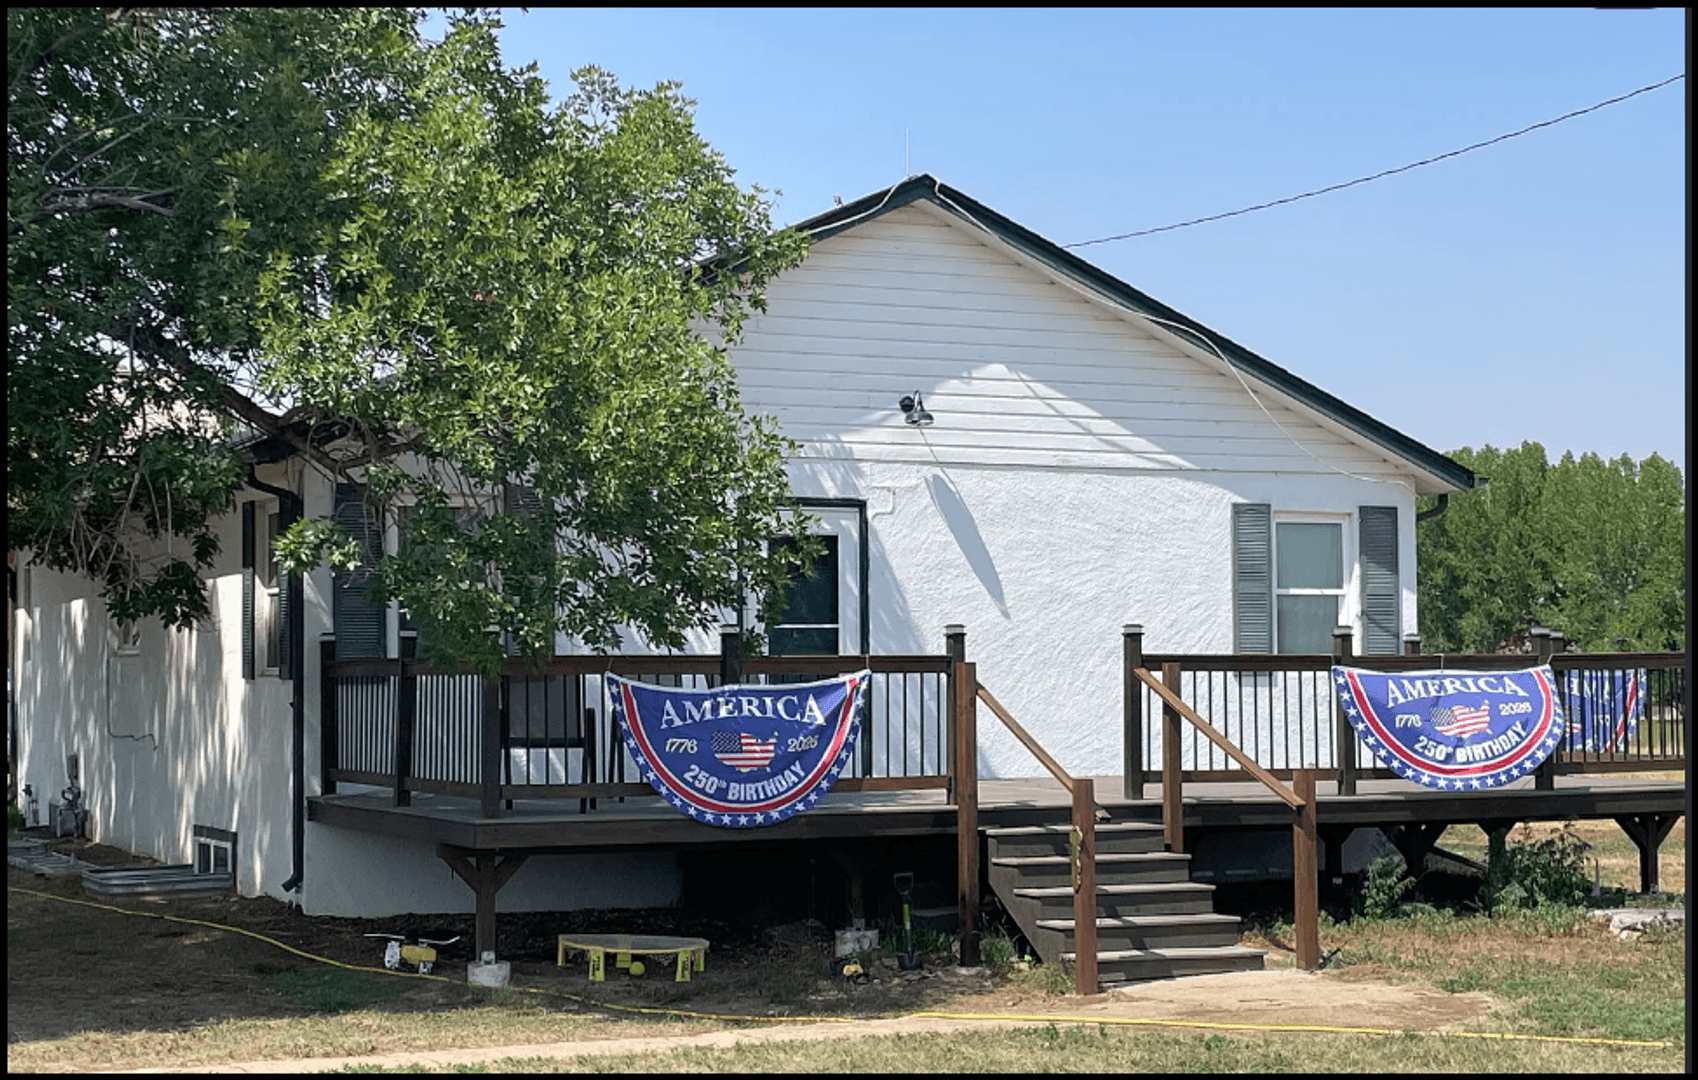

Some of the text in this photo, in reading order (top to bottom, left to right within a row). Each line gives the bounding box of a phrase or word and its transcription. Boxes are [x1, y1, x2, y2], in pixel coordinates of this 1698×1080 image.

[1387, 676, 1530, 708] AMERICA
[660, 693, 827, 729] AMERICA
[1395, 714, 1423, 728] 1776
[665, 738, 698, 754] 1776
[1414, 736, 1454, 761] 250
[1455, 720, 1527, 763] BIRTHDAY
[727, 759, 806, 801] BIRTHDAY
